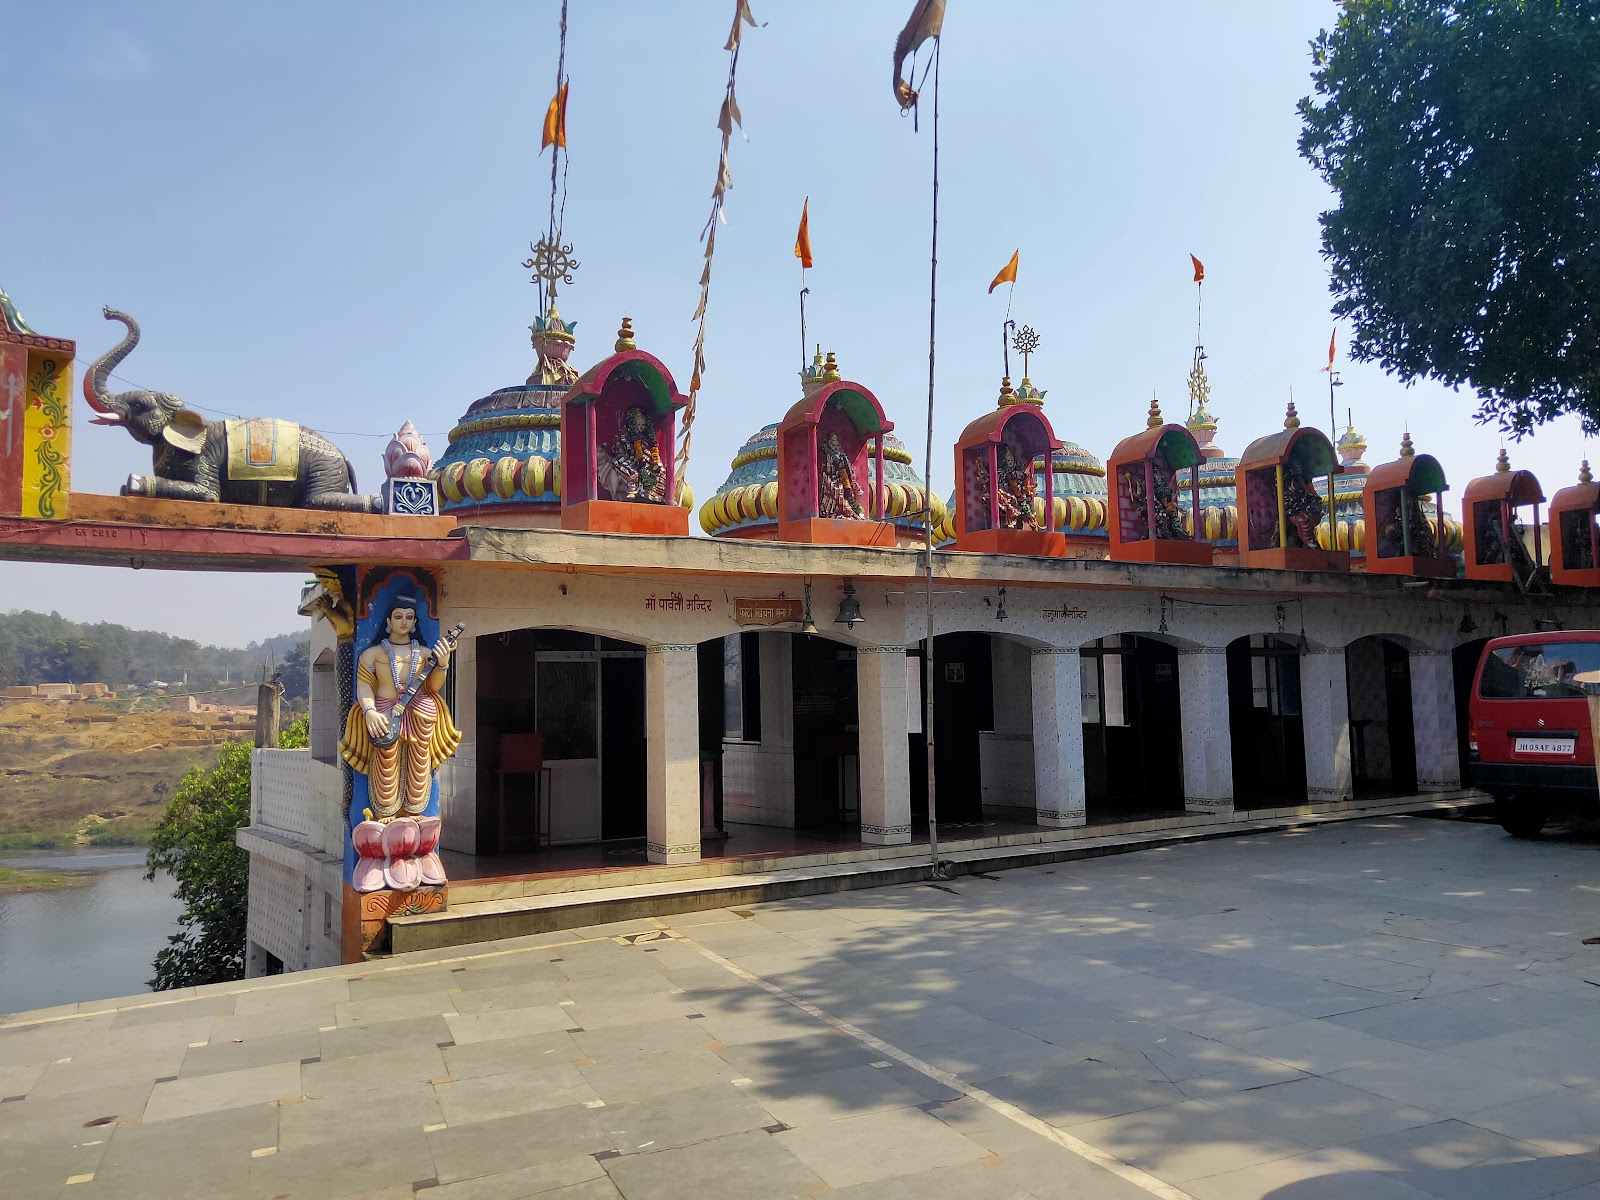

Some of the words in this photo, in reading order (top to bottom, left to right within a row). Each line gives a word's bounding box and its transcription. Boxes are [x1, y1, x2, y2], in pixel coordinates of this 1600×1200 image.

[645, 592, 656, 611] माँ
[658, 591, 684, 611] पार्वती
[686, 593, 712, 612] मन्दिर
[1552, 744, 1572, 753] 4877
